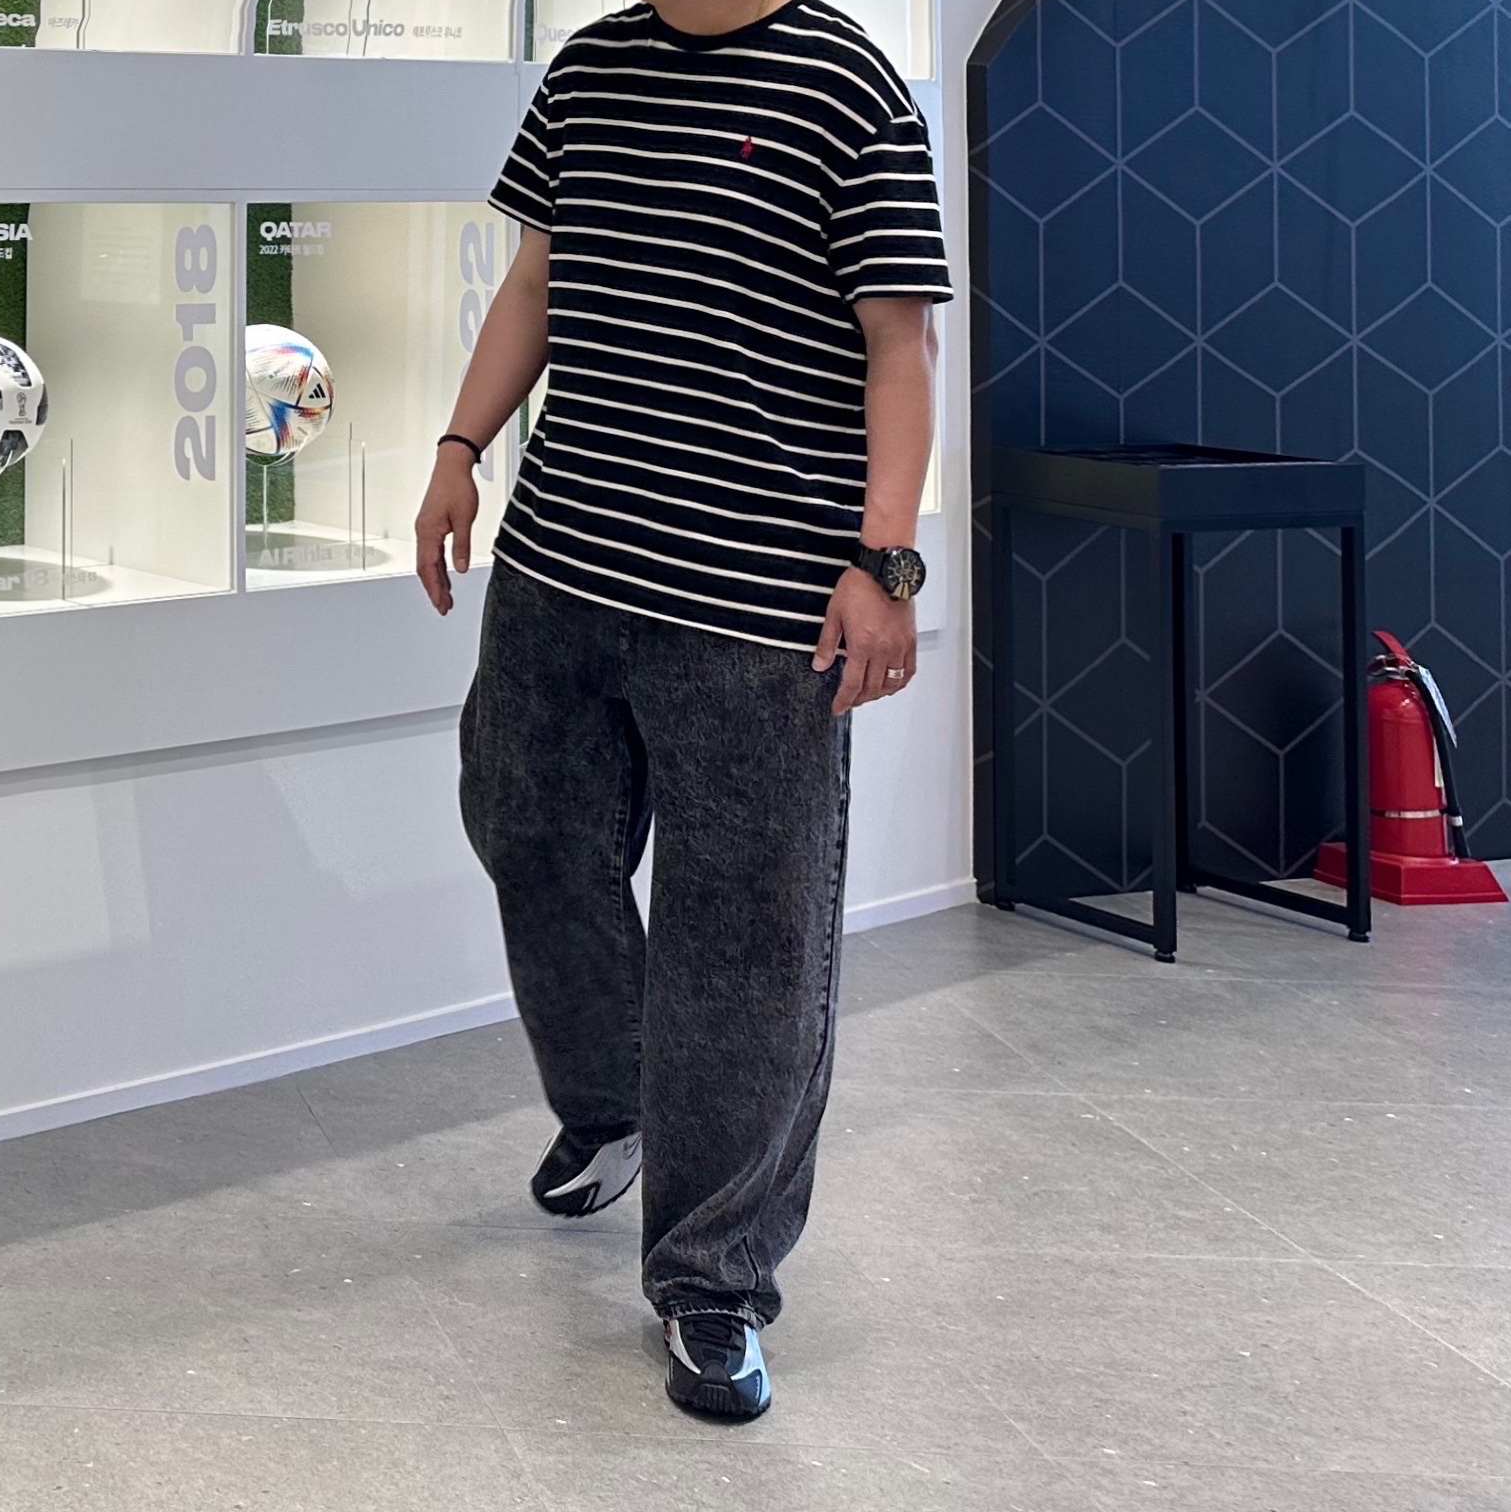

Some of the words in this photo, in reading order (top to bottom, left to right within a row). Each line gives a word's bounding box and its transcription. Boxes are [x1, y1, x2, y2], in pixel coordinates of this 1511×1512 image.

[268, 19, 347, 37] Etrusco
[352, 19, 405, 37] Unico
[260, 221, 332, 241] QATAR
[259, 244, 278, 255] 2022
[174, 223, 218, 482] 2018
